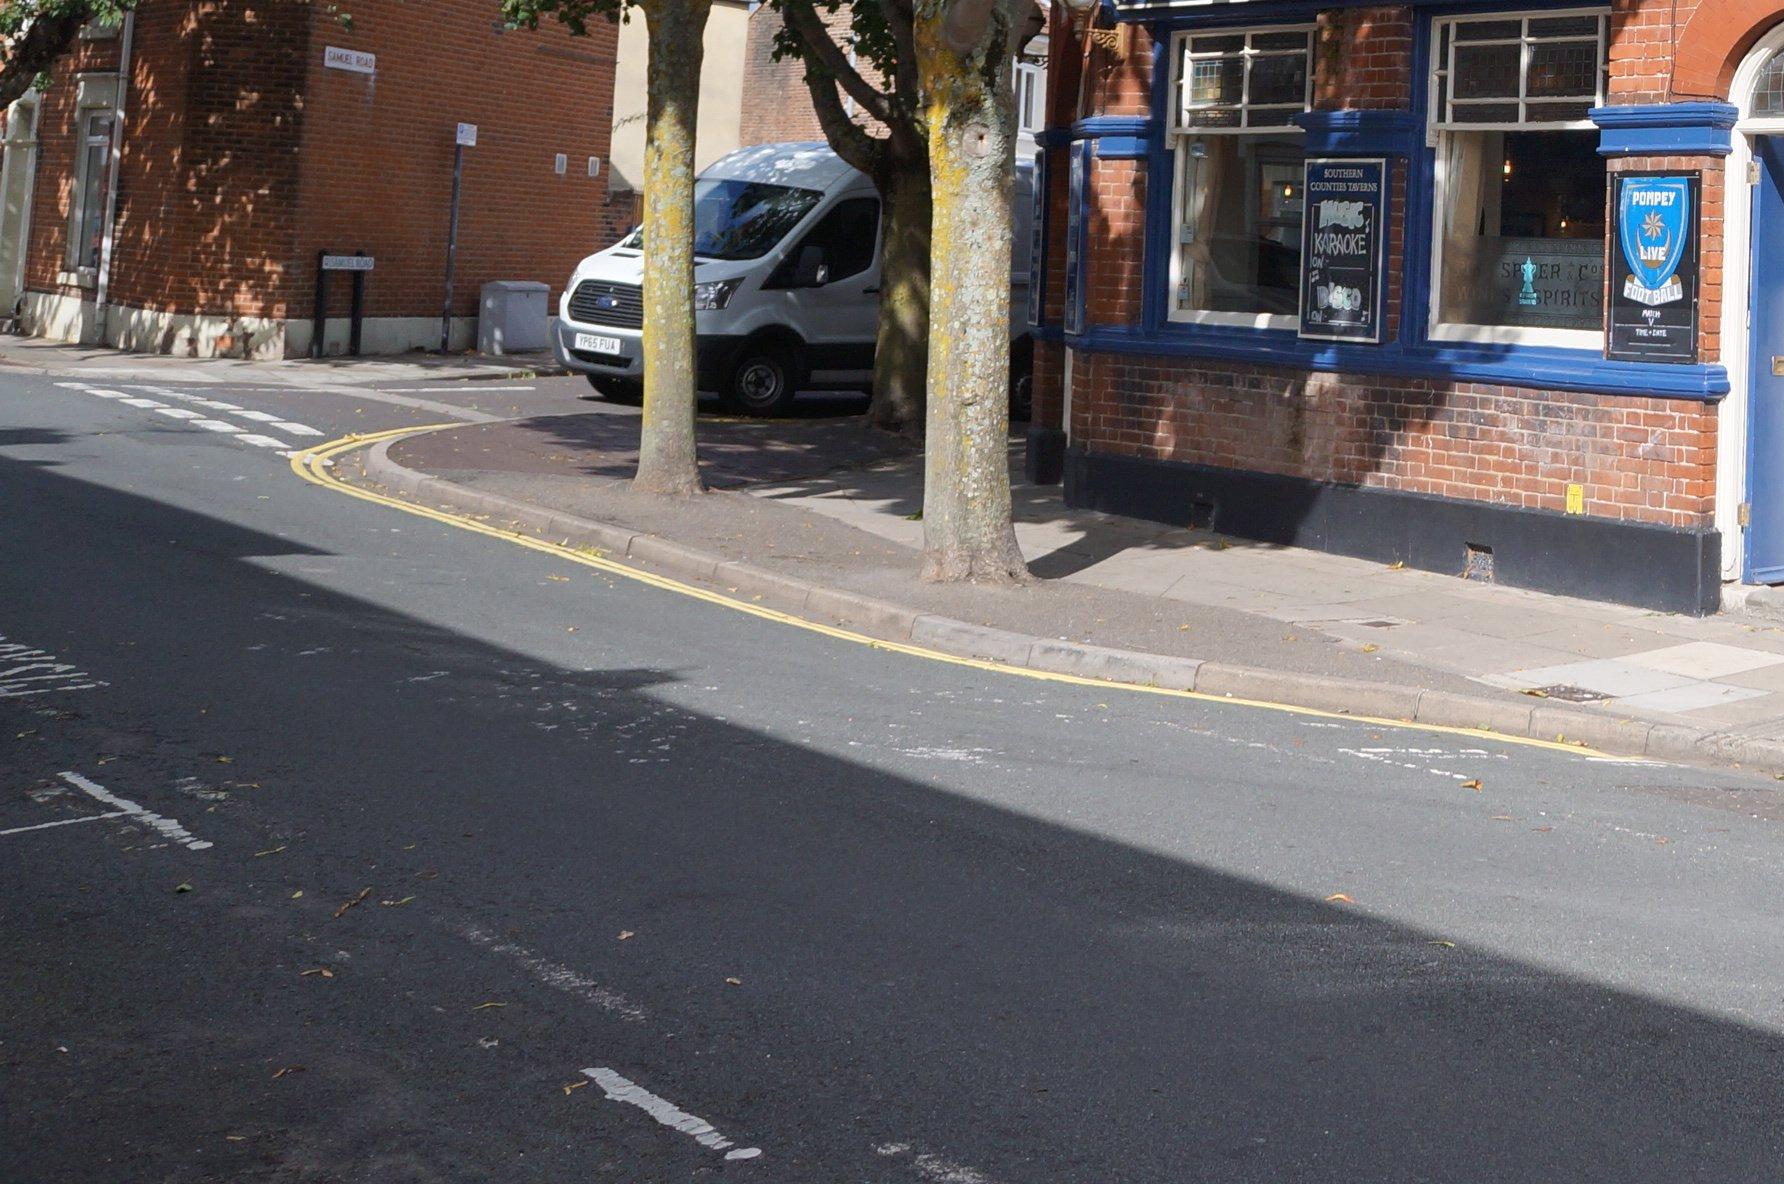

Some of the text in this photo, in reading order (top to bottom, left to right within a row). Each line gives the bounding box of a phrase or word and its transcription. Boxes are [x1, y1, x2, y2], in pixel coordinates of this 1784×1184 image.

[1324, 169, 1363, 178] SOUTHERN
[1310, 182, 1377, 192] COUNTIES TAVERNS
[1632, 191, 1675, 206] POMPEY
[1314, 233, 1366, 256] KARAOKE
[1640, 246, 1666, 261] LIVE
